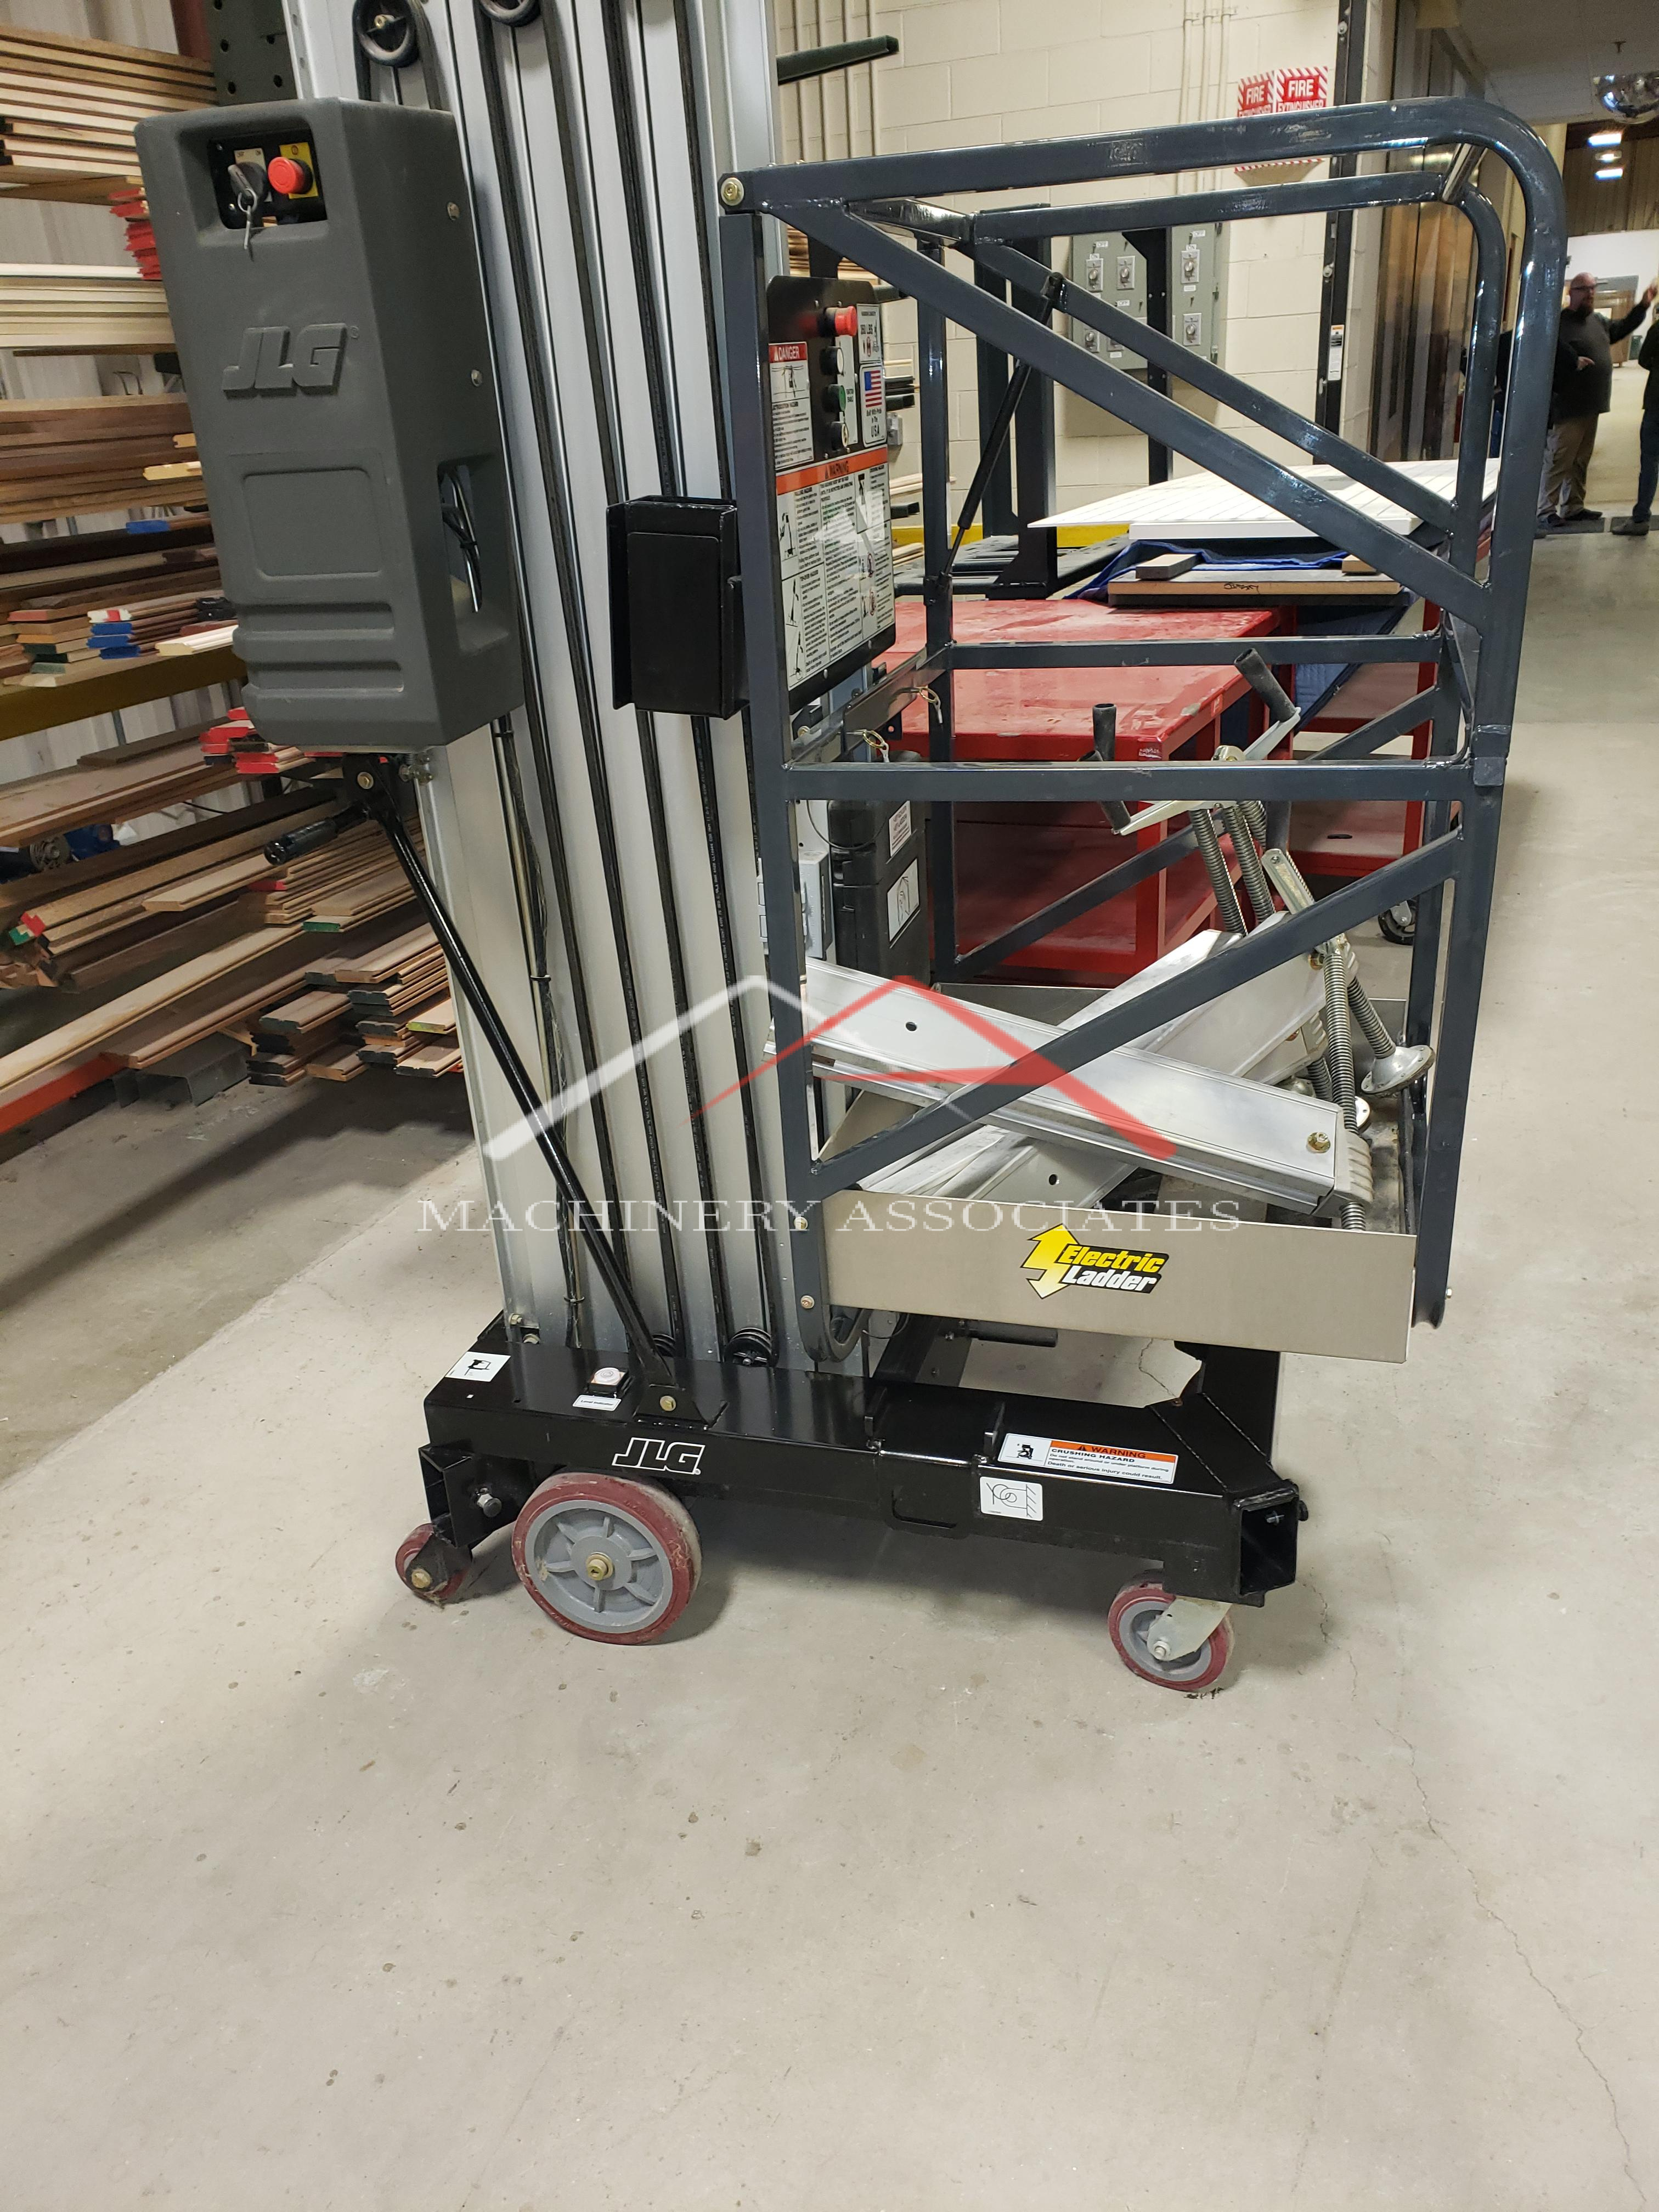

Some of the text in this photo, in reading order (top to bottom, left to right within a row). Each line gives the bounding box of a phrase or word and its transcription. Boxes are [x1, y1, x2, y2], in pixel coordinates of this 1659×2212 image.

[1246, 84, 1265, 105] FIRE
[1288, 78, 1314, 98] FIRE
[222, 323, 347, 399] JLG
[778, 346, 800, 360] DANGER
[829, 460, 849, 475] WARNING
[1057, 1245, 1165, 1273] Electric
[1062, 1265, 1158, 1292] Ladder
[612, 1437, 706, 1475] JLG
[1051, 1448, 1135, 1463] CRUSHING HAZARD
[1091, 1446, 1146, 1459] WARNING
